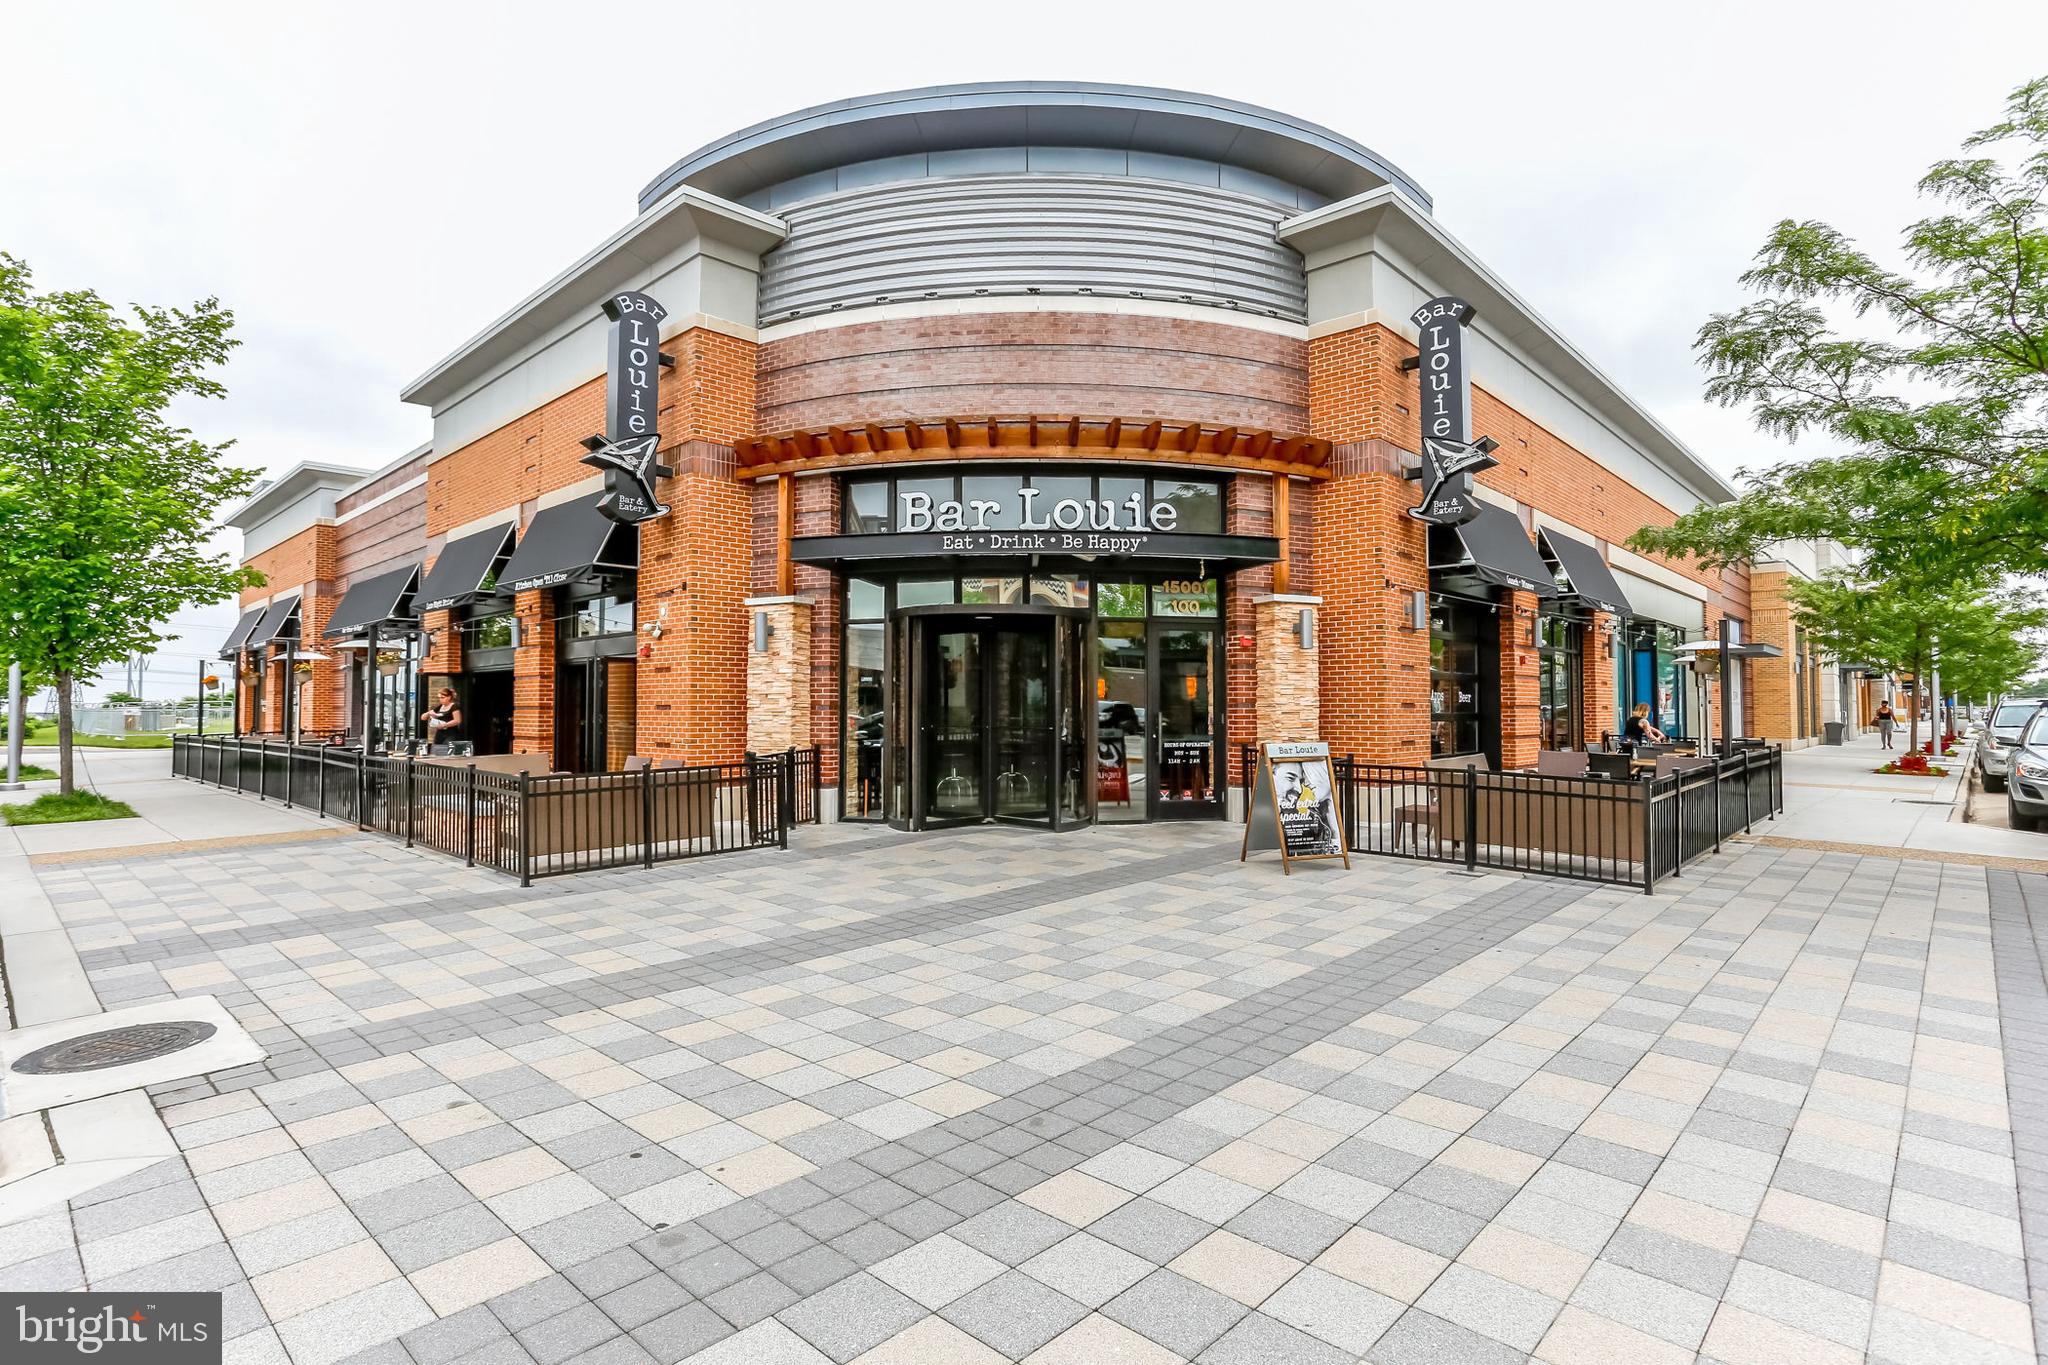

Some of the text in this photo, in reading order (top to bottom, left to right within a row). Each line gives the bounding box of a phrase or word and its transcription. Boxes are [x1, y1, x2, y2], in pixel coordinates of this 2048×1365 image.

[617, 295, 664, 434] Bar Louie
[1414, 302, 1463, 437] Bar Louie
[619, 494, 644, 506] Bar &
[1433, 497, 1459, 508] Bar &
[618, 502, 649, 514] Eatery
[899, 487, 1178, 533] Bar Louie
[1433, 505, 1464, 516] Eatery
[942, 535, 974, 550] Eat
[990, 534, 1045, 550] Drink
[1061, 534, 1083, 550] Be
[1162, 580, 1208, 594] 15001
[1171, 599, 1200, 613] 100
[1278, 745, 1319, 755] Bar Louie
